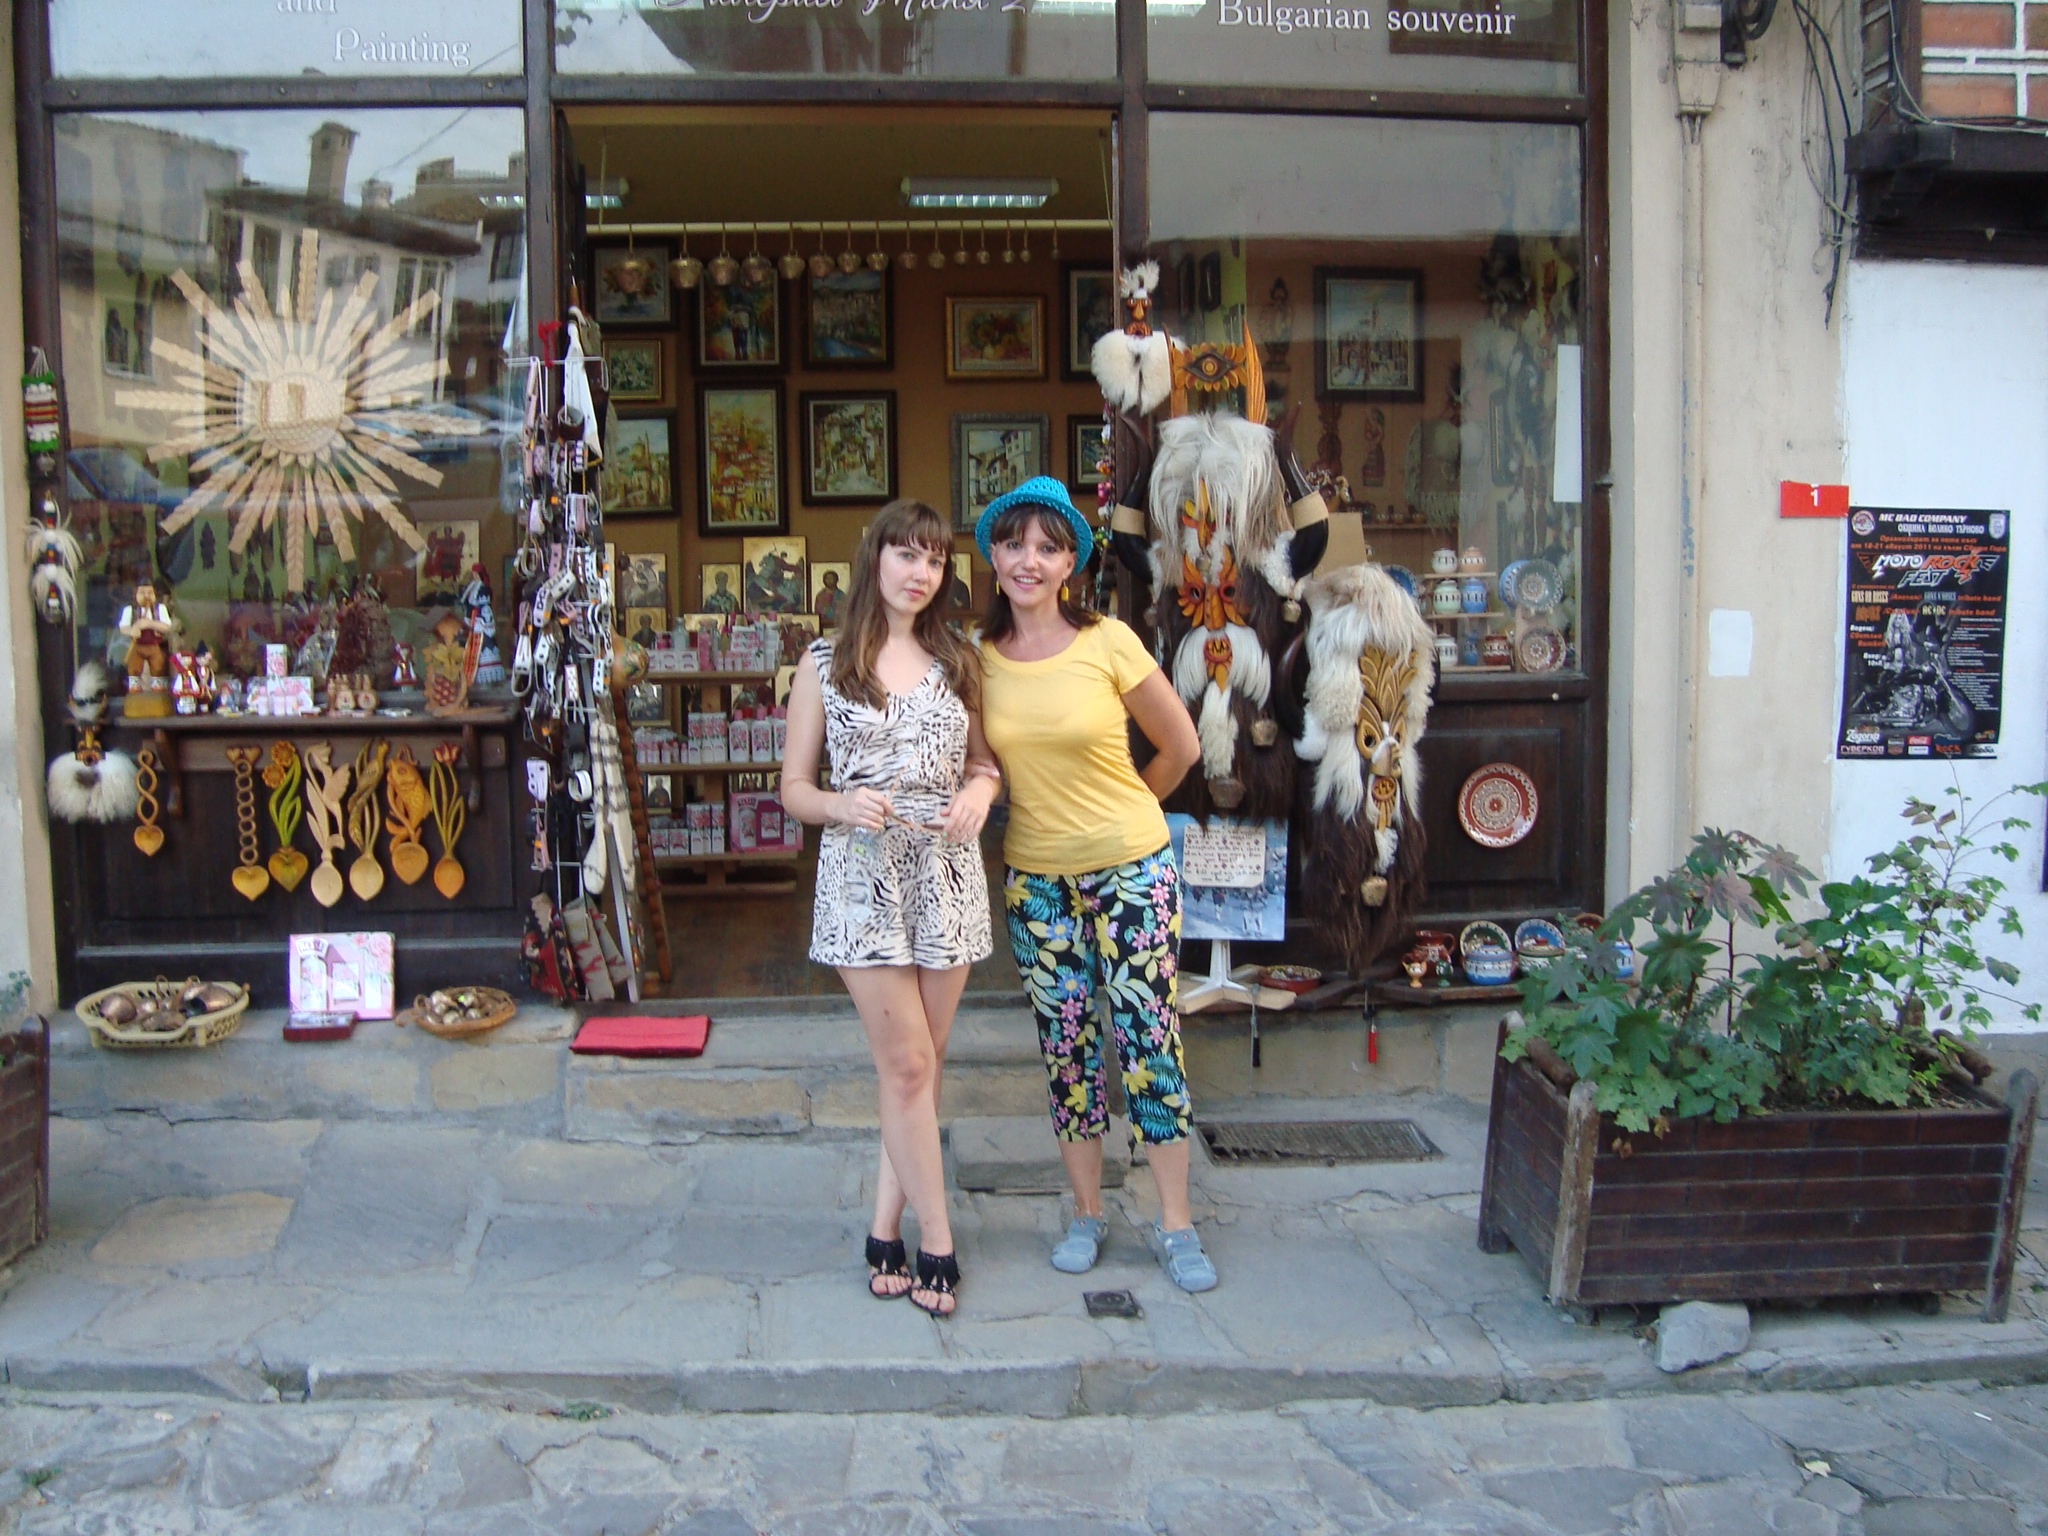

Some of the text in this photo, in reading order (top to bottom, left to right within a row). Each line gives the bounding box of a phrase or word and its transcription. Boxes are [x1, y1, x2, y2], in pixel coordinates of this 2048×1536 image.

[1218, 0, 1516, 34] Bulgarian souvenir
[332, 27, 471, 69] Painting
[1810, 489, 1820, 507] 1
[1878, 513, 1967, 523] MC BAD COMPANY
[1872, 554, 1924, 579] MOTO
[1897, 569, 1949, 588] FEST
[1983, 594, 2002, 602] band
